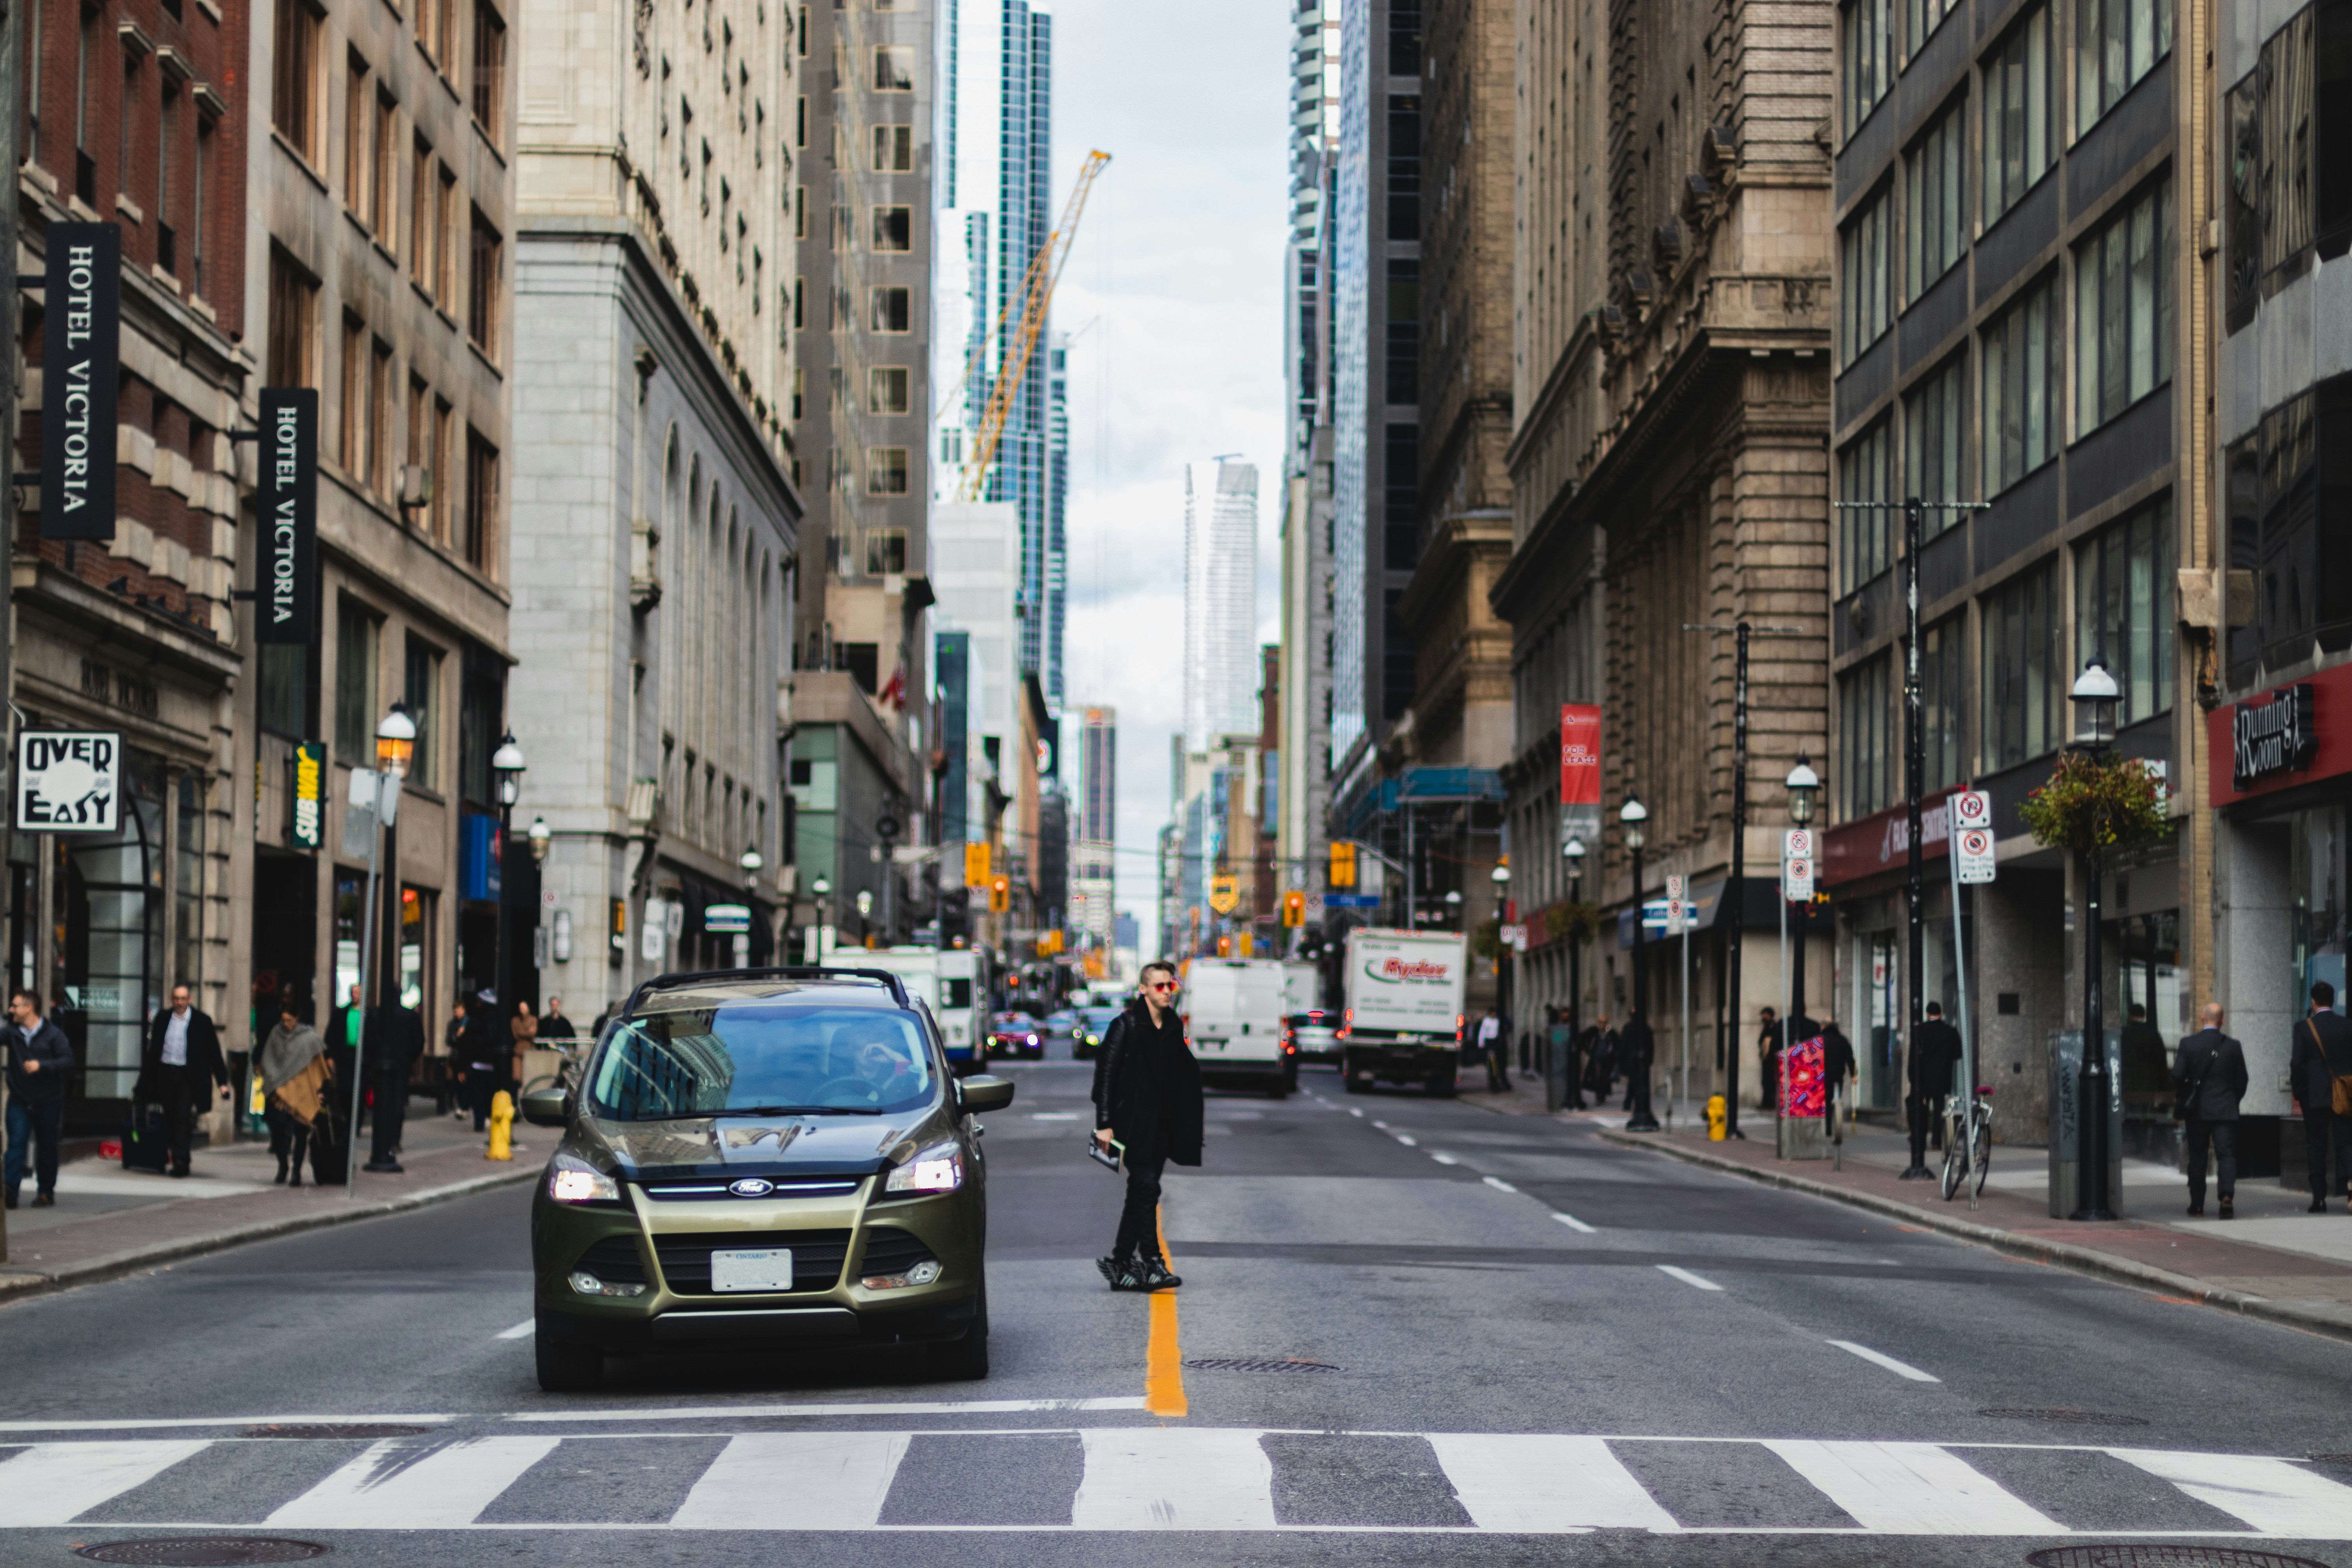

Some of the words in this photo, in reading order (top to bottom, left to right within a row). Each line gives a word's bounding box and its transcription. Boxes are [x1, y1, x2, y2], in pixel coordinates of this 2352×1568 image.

[67, 245, 93, 350] HOTEL
[64, 359, 91, 514] VICTORIA
[276, 407, 298, 492] HOTEL
[273, 498, 296, 624] VICTORIA
[2241, 693, 2291, 750] Running
[2241, 718, 2282, 777] Room
[27, 737, 111, 773] OVER
[25, 789, 111, 824] EASY
[296, 746, 319, 846] SUBWAY
[1383, 958, 1449, 979] Ryder
[738, 1181, 764, 1193] Ford
